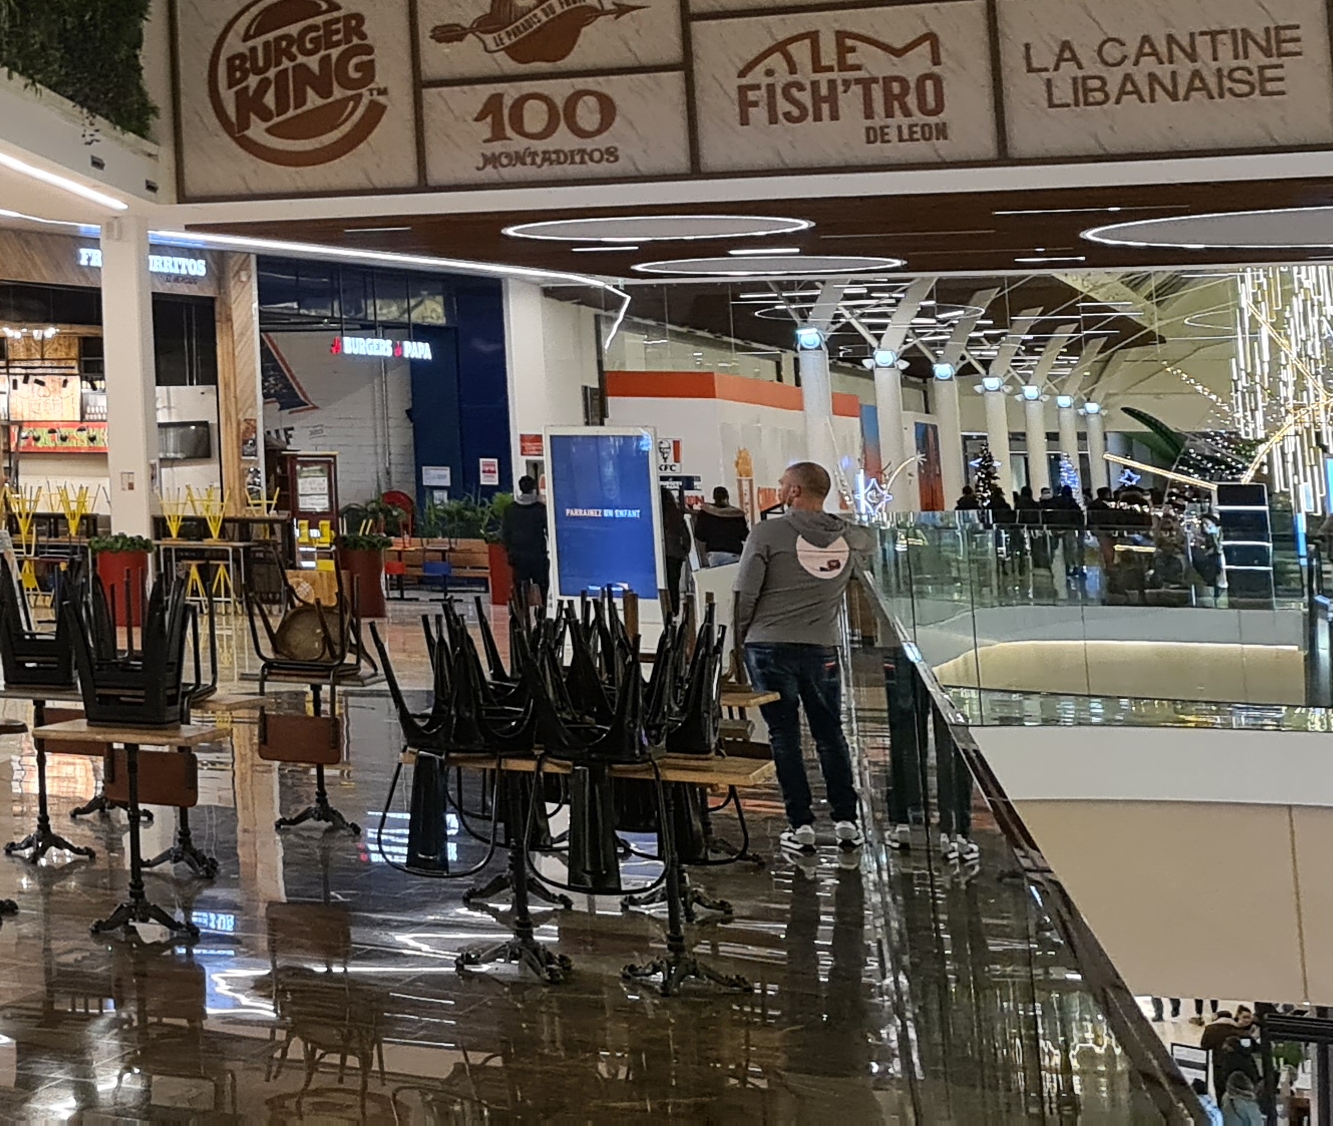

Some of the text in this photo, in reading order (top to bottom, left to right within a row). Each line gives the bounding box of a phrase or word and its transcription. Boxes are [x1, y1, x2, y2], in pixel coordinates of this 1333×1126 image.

[493, 32, 505, 48] LE
[505, 12, 542, 41] PARADIS
[540, 2, 556, 18] DU
[226, 12, 368, 91] BURGER
[1023, 23, 1303, 74] LA CANTINE
[234, 43, 376, 135] KING
[1045, 63, 1287, 110] LIBANAISE
[473, 88, 617, 144] 100
[865, 121, 949, 145] DE LEON
[476, 145, 620, 172] MONTADITOS
[342, 336, 432, 360] BURGERS PAPA
[658, 463, 677, 472] KFC
[614, 508, 641, 519] ENFANT
